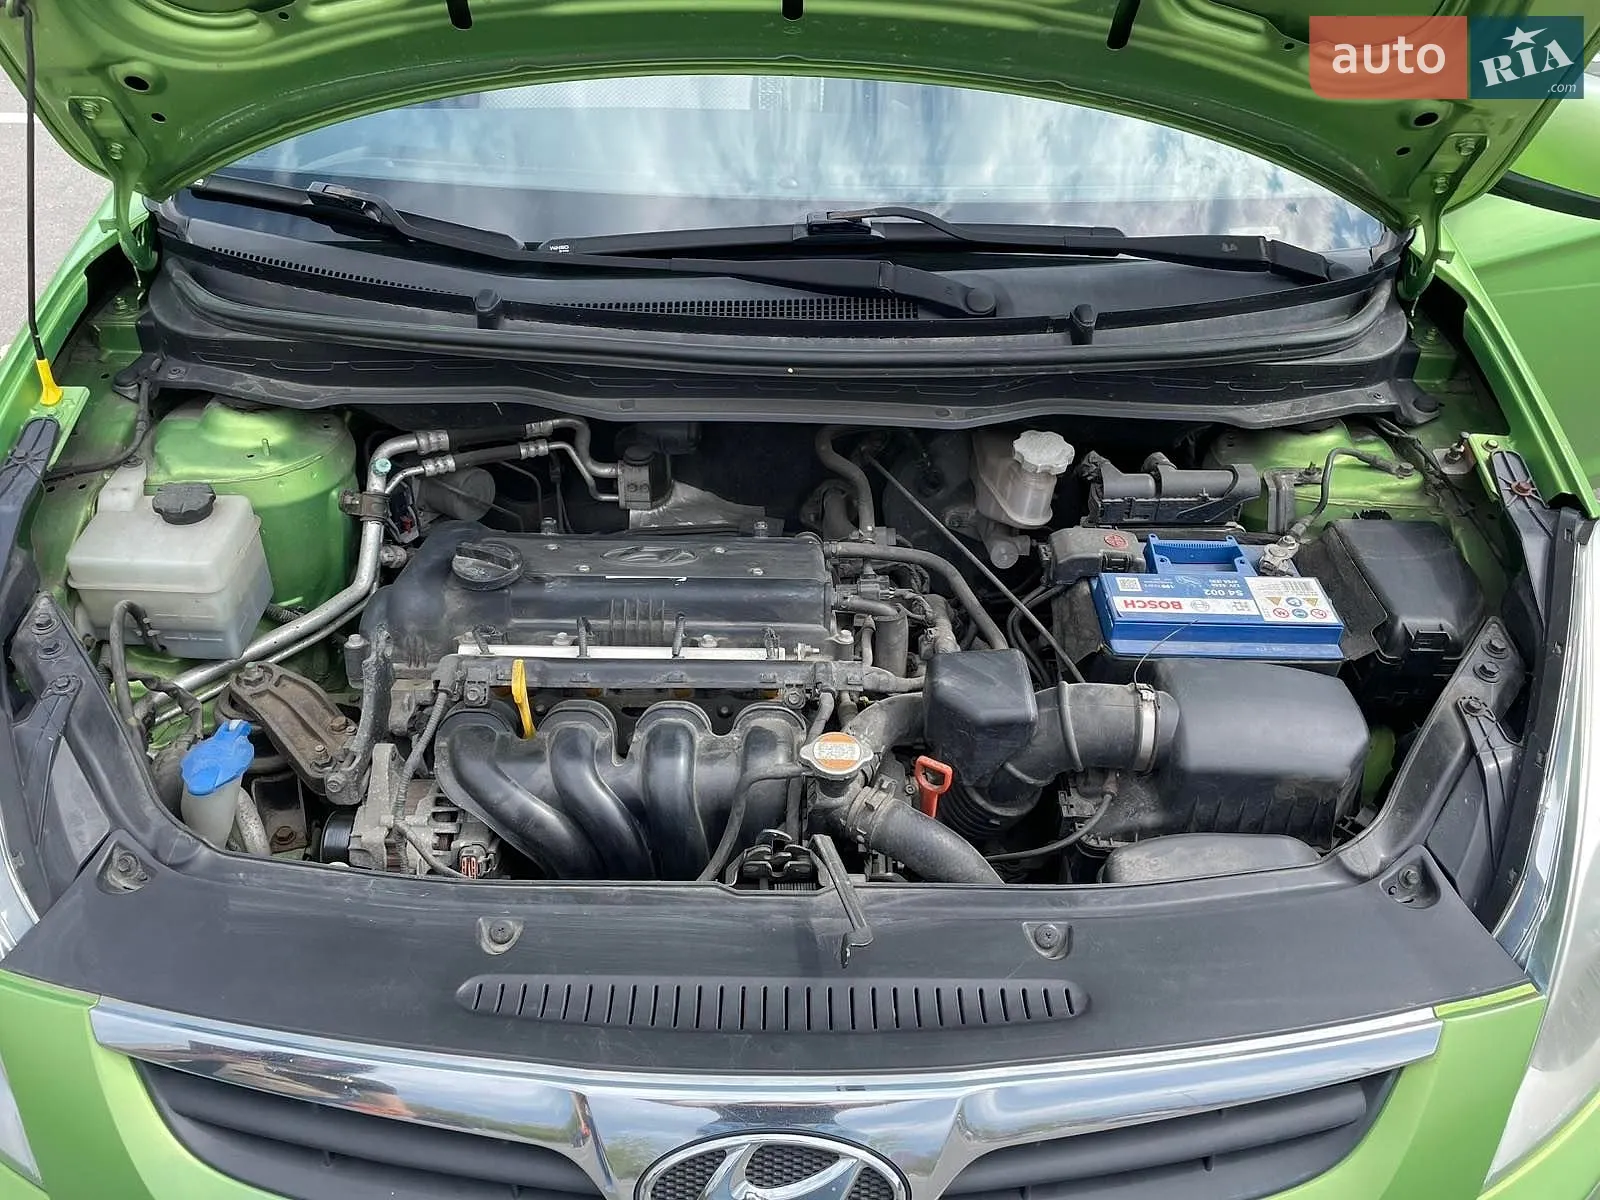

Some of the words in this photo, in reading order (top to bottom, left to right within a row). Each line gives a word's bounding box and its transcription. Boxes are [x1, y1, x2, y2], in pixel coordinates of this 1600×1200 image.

[1203, 588, 1226, 596] 002
[1229, 589, 1244, 597] S4
[1123, 600, 1184, 610] BOSCH
